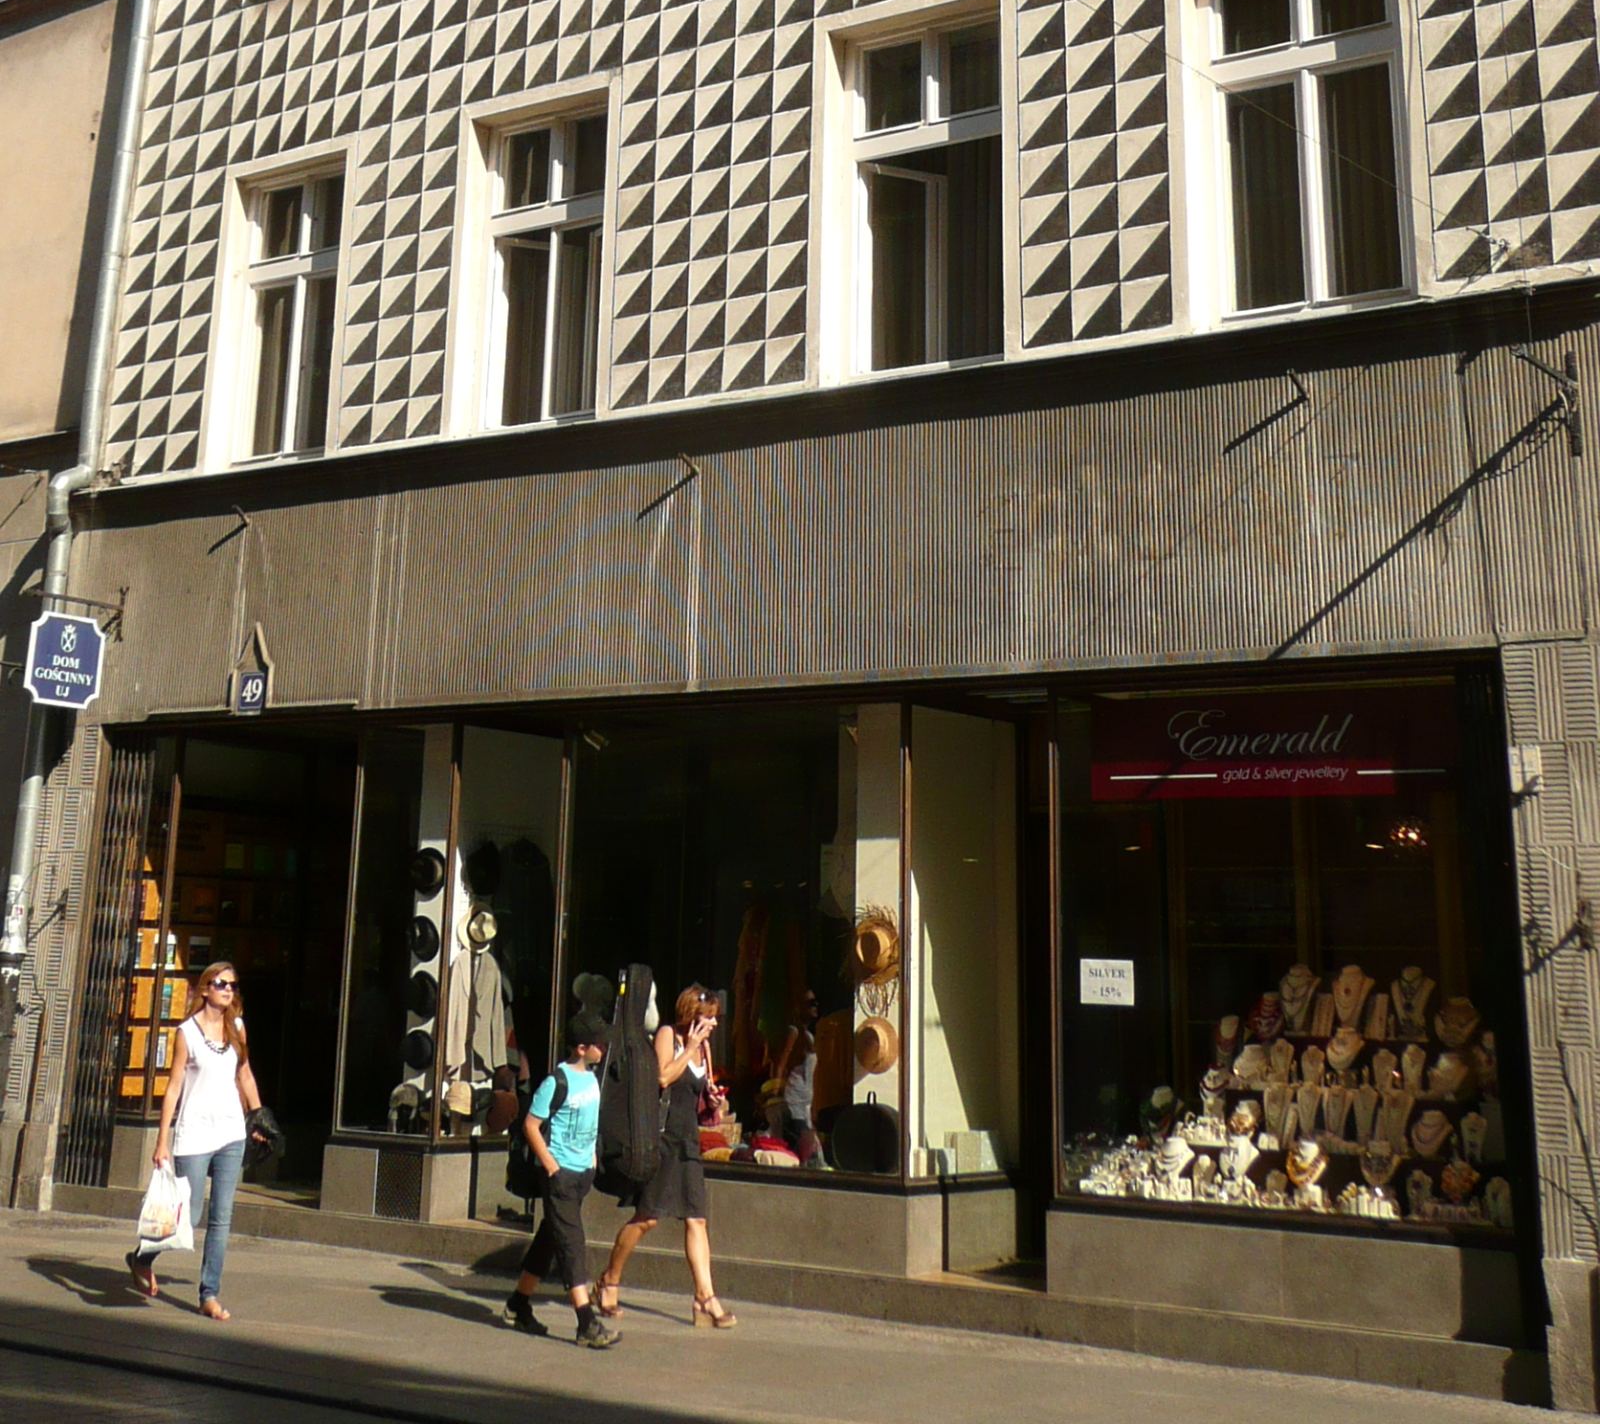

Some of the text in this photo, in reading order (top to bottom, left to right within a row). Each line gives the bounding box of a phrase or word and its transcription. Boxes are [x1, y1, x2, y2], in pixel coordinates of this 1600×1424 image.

[52, 654, 80, 669] DOM
[34, 666, 93, 686] GOŚCINNY
[55, 684, 70, 698] UJ
[242, 678, 263, 703] 49
[1167, 709, 1353, 761] Emerald
[1222, 765, 1349, 783] gold & silver jewellery
[1088, 968, 1126, 978] SILVER
